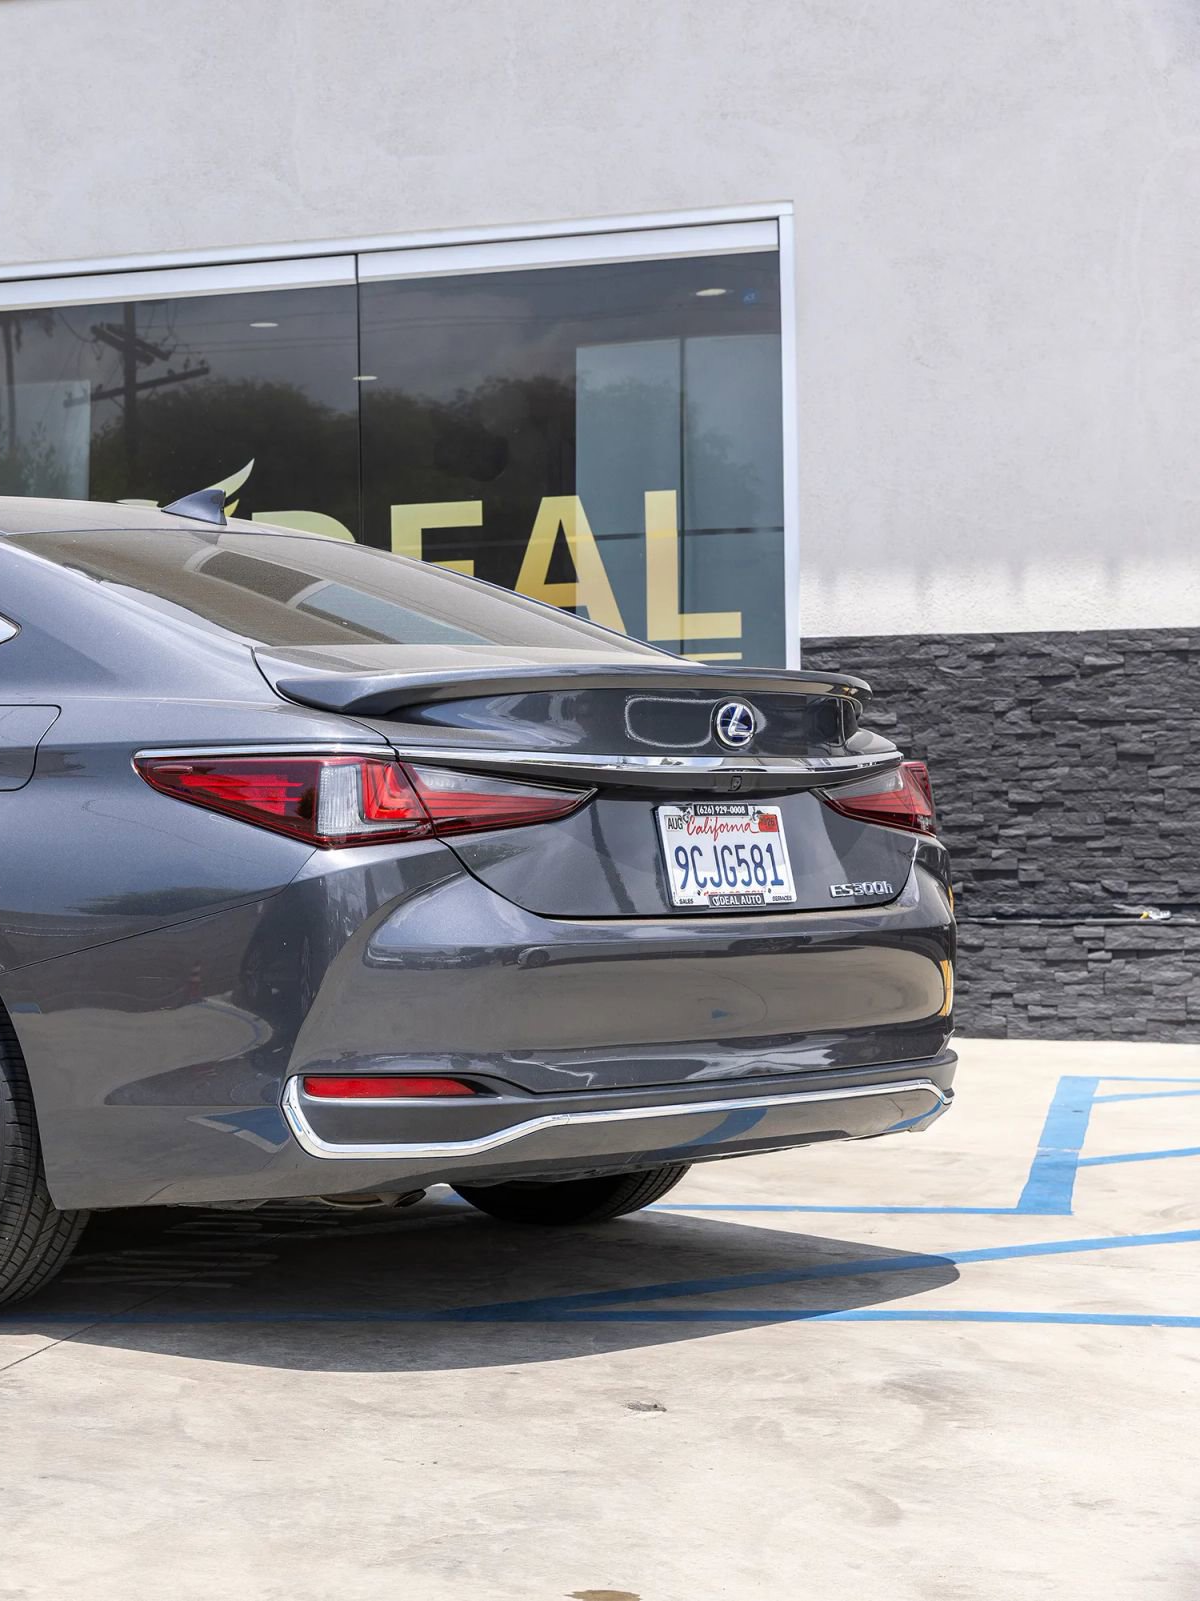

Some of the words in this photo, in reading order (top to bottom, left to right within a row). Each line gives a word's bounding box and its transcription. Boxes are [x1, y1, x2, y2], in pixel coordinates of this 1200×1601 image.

[252, 490, 742, 642] AL
[697, 805, 714, 816] (626)
[667, 816, 684, 831] AUG
[686, 814, 757, 842] California
[674, 843, 785, 890] 9CJG581
[829, 880, 894, 898] ES300h
[740, 894, 763, 905] AUTO
